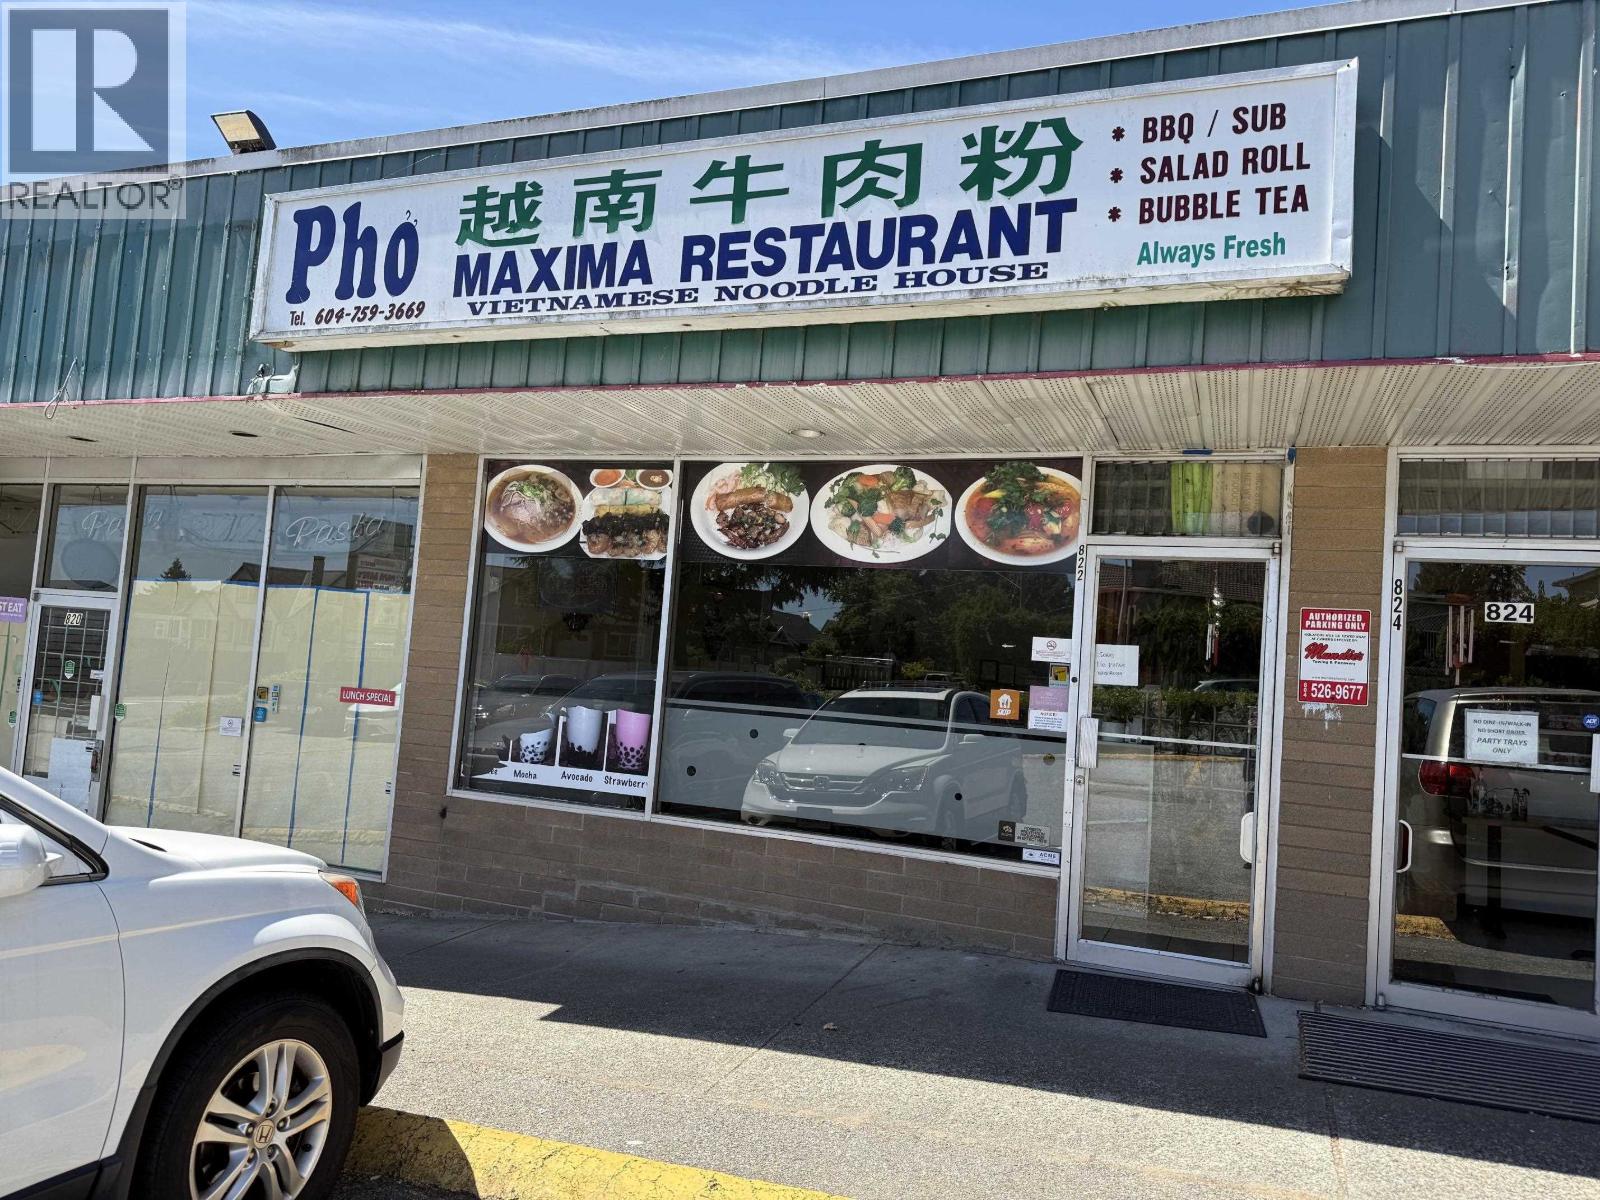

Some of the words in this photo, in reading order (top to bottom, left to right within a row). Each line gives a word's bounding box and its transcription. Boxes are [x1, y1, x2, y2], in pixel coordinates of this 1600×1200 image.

[1142, 112, 1194, 144] BBQ
[1231, 102, 1287, 134] SUB
[1139, 150, 1229, 184] SALAD
[1241, 142, 1311, 175] ROLL
[455, 117, 1083, 247] 越南牛肉粉
[1138, 189, 1241, 224] BUBBLE
[1254, 184, 1309, 215] TEA
[452, 239, 653, 298] MAXIMA
[680, 198, 1078, 282] RESTAURANT
[1136, 240, 1216, 268] Always
[1223, 231, 1286, 260] Fresh
[467, 287, 699, 315] VIETNAMESE
[714, 274, 877, 301] NOODLE
[893, 261, 1049, 289] HOUSE
[289, 310, 306, 326] Tel.
[314, 300, 426, 325] 604-759-3669
[285, 511, 385, 547] Pasta
[1077, 544, 1085, 581] 822
[8, 602, 24, 613] EAT
[1392, 579, 1403, 631] 824
[1486, 602, 1534, 623] 824
[65, 613, 83, 625] 820
[1305, 621, 1343, 630] PARKING
[1344, 622, 1366, 631] ONLY
[1308, 612, 1363, 622] AUTHORIZED
[342, 690, 365, 701] LUNCH
[366, 692, 393, 704] SPECIAL
[1310, 683, 1364, 701] 526-9677
[1476, 737, 1502, 745] PARTY
[1503, 738, 1528, 746] TRAYS
[513, 769, 537, 780] Mocha
[560, 770, 593, 783] Avocado
[603, 775, 648, 789] Strawberr
